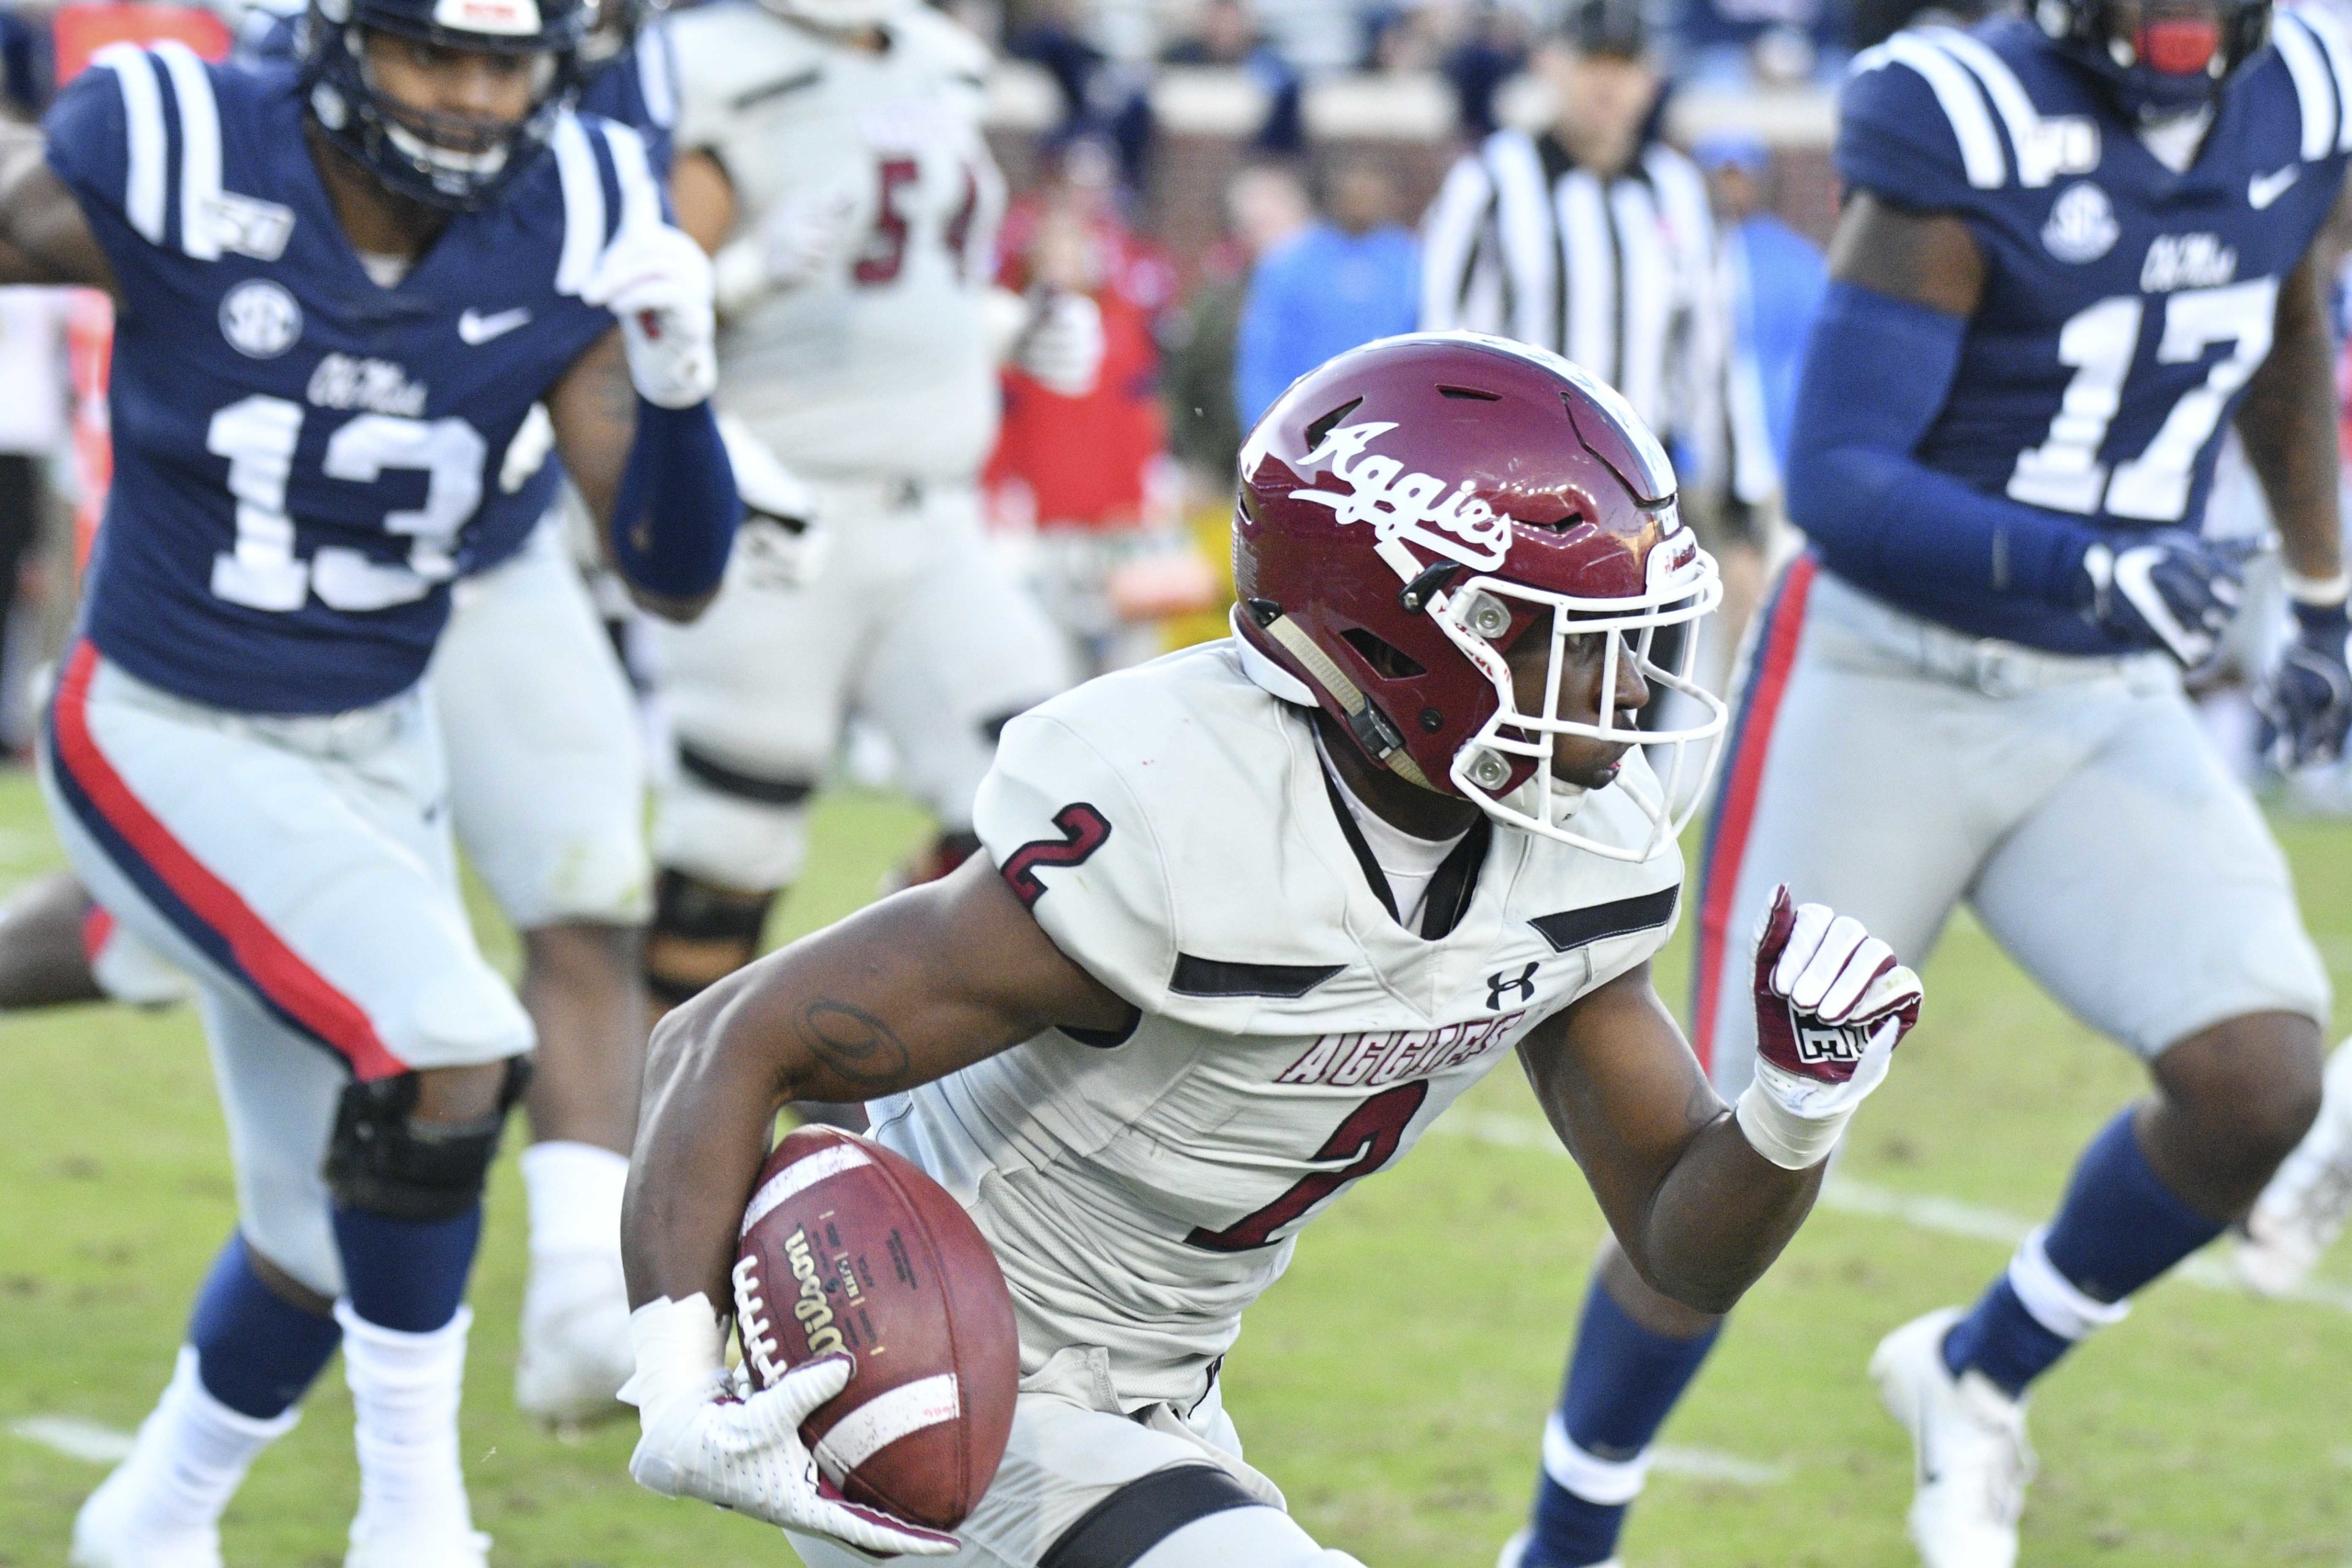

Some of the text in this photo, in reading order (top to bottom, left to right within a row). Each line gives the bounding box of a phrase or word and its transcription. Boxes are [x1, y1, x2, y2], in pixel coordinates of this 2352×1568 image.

[2007, 276, 2280, 522] 17
[207, 394, 488, 612] 13
[1288, 421, 1511, 572] Aggies
[1001, 801, 1113, 909] 2
[1272, 1010, 1527, 1087] AGGIES
